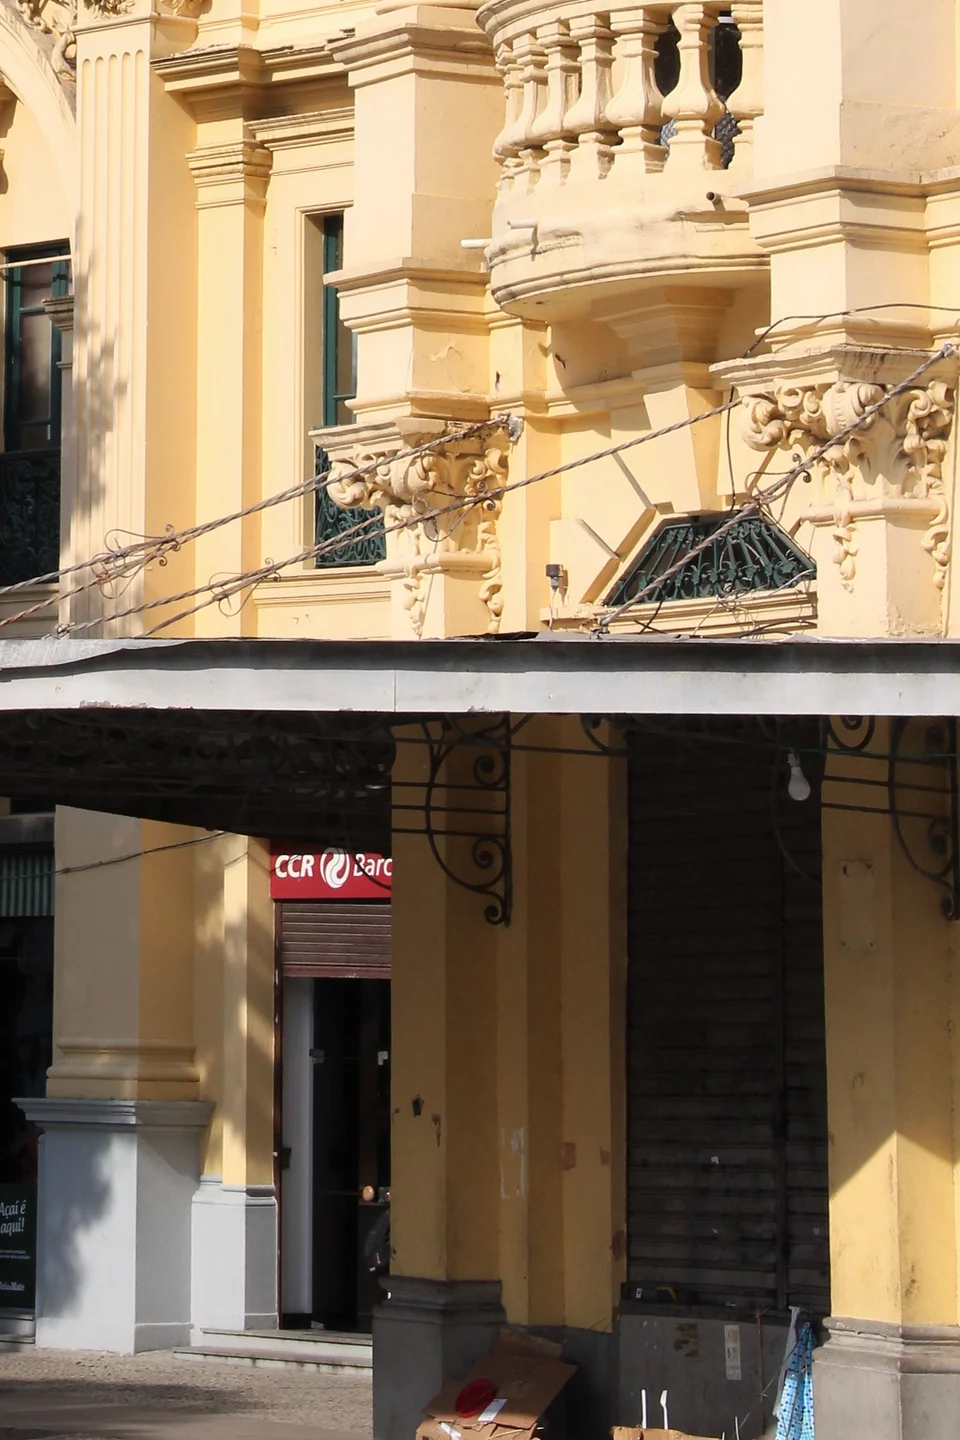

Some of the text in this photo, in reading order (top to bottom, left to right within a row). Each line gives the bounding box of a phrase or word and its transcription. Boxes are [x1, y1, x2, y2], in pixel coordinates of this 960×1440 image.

[275, 854, 315, 878] CCR
[20, 1199, 27, 1215] é
[0, 1217, 25, 1237] aqui!
